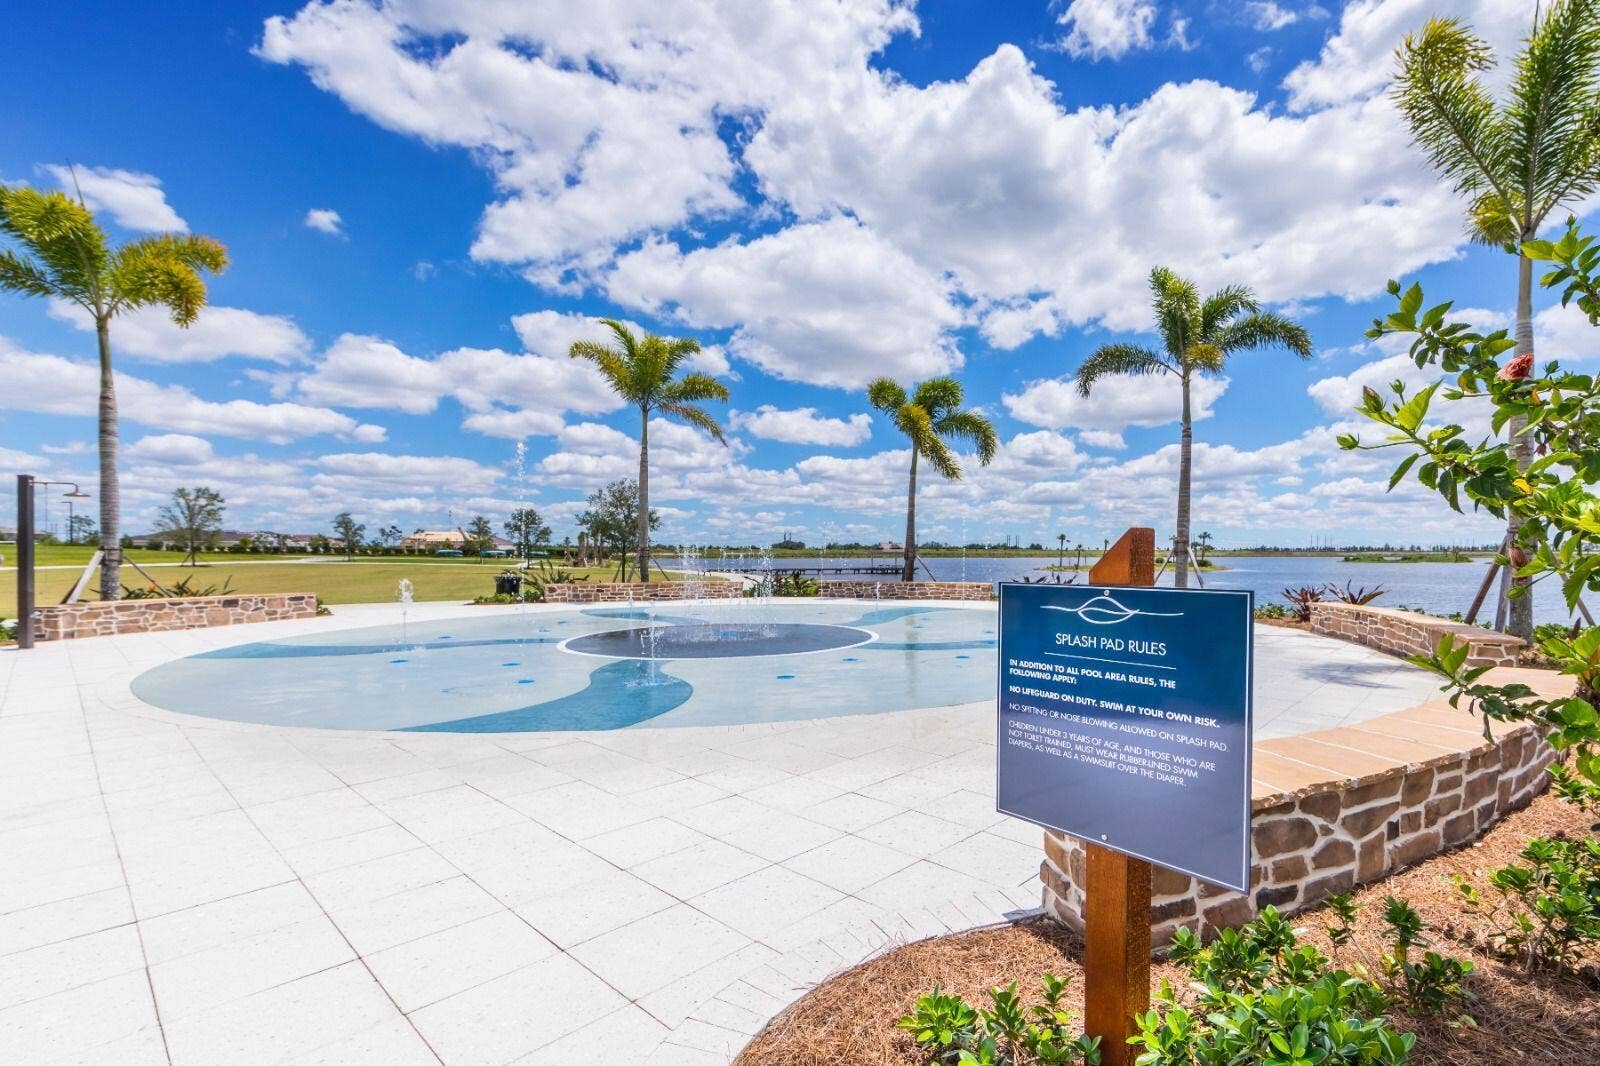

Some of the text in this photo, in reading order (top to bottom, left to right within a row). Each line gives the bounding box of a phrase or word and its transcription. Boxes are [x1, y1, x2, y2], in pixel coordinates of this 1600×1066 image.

[1056, 632, 1167, 655] SPLASH PAD RULES
[1010, 659, 1176, 689] IN ADDITION TO ALL POOL AREA RULES, THE
[1010, 667, 1077, 684] FOLLOWING APPLY:
[1010, 685, 1221, 728] NO LIFEGUARD ON DUTY. SWIM AT YOUR OWN RISK.
[1010, 703, 1020, 712] NO
[1022, 705, 1048, 716] SPITTING
[1050, 711, 1060, 719] OR
[1061, 713, 1081, 723] NOSE
[1082, 717, 1118, 729] BLOWING
[1120, 724, 1158, 737] ALLOWED
[1159, 731, 1174, 741] ON
[1176, 735, 1207, 747] SPLASH
[1009, 720, 1038, 731] CHILDREN
[1040, 727, 1061, 737] UNDER
[1069, 733, 1091, 743] YEARS
[1092, 738, 1102, 746] OF
[1124, 745, 1142, 755] AND
[1144, 749, 1171, 761] THOSE
[1172, 754, 1197, 767] WHO
[1200, 761, 1216, 771] ARE
[1009, 730, 1023, 738] NOT
[1024, 732, 1043, 742] TOILET
[1075, 744, 1095, 754] MUST
[1096, 747, 1118, 759] WEAR
[1173, 766, 1199, 778] SWIM
[1035, 744, 1046, 753] AS
[1046, 747, 1062, 757] WELL
[1062, 751, 1073, 759] AS
[1081, 755, 1118, 768] SWIMSUIT
[1118, 763, 1139, 773] OVER
[1140, 768, 1155, 778] THE
